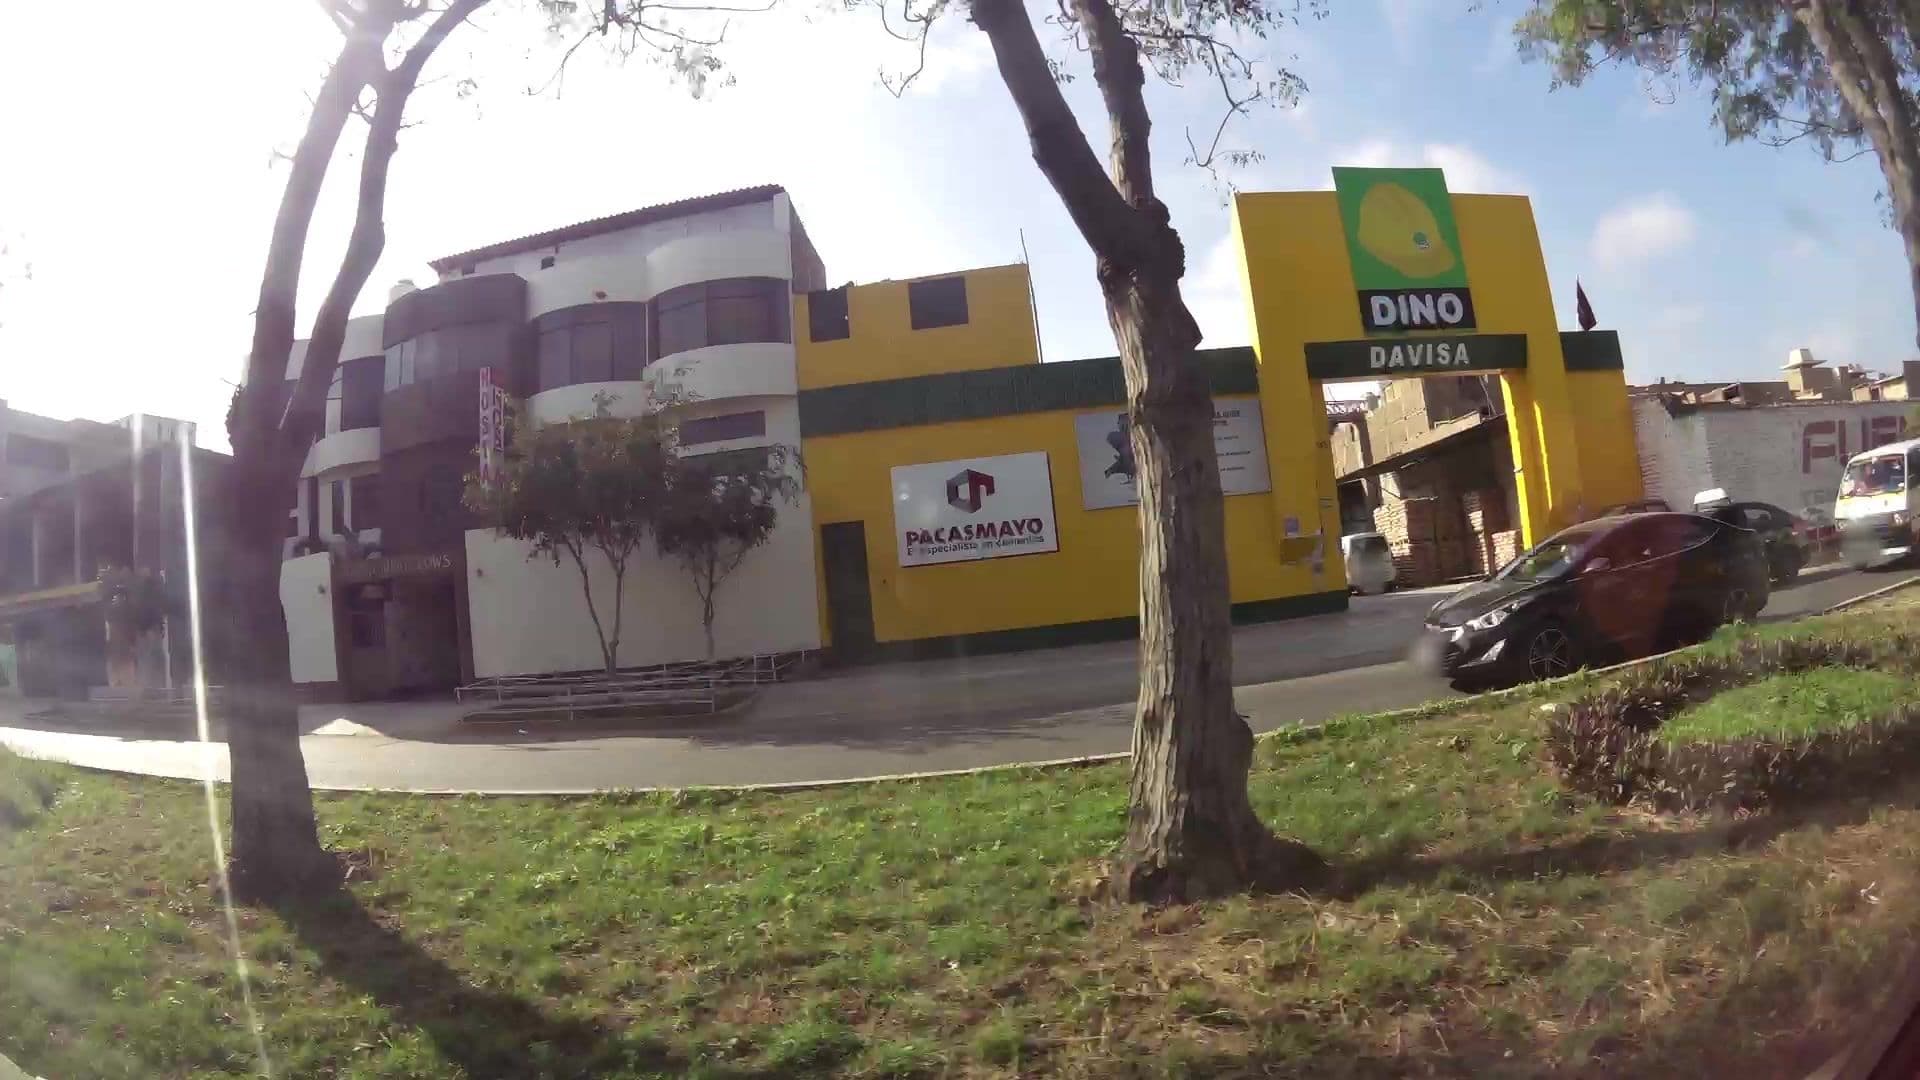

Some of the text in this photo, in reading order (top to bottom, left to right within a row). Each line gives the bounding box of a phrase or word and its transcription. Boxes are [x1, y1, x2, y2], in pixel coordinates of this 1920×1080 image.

[1370, 292, 1464, 326] DINO
[1370, 343, 1470, 369] DAVISA
[905, 518, 1044, 546] PACASMAYO
